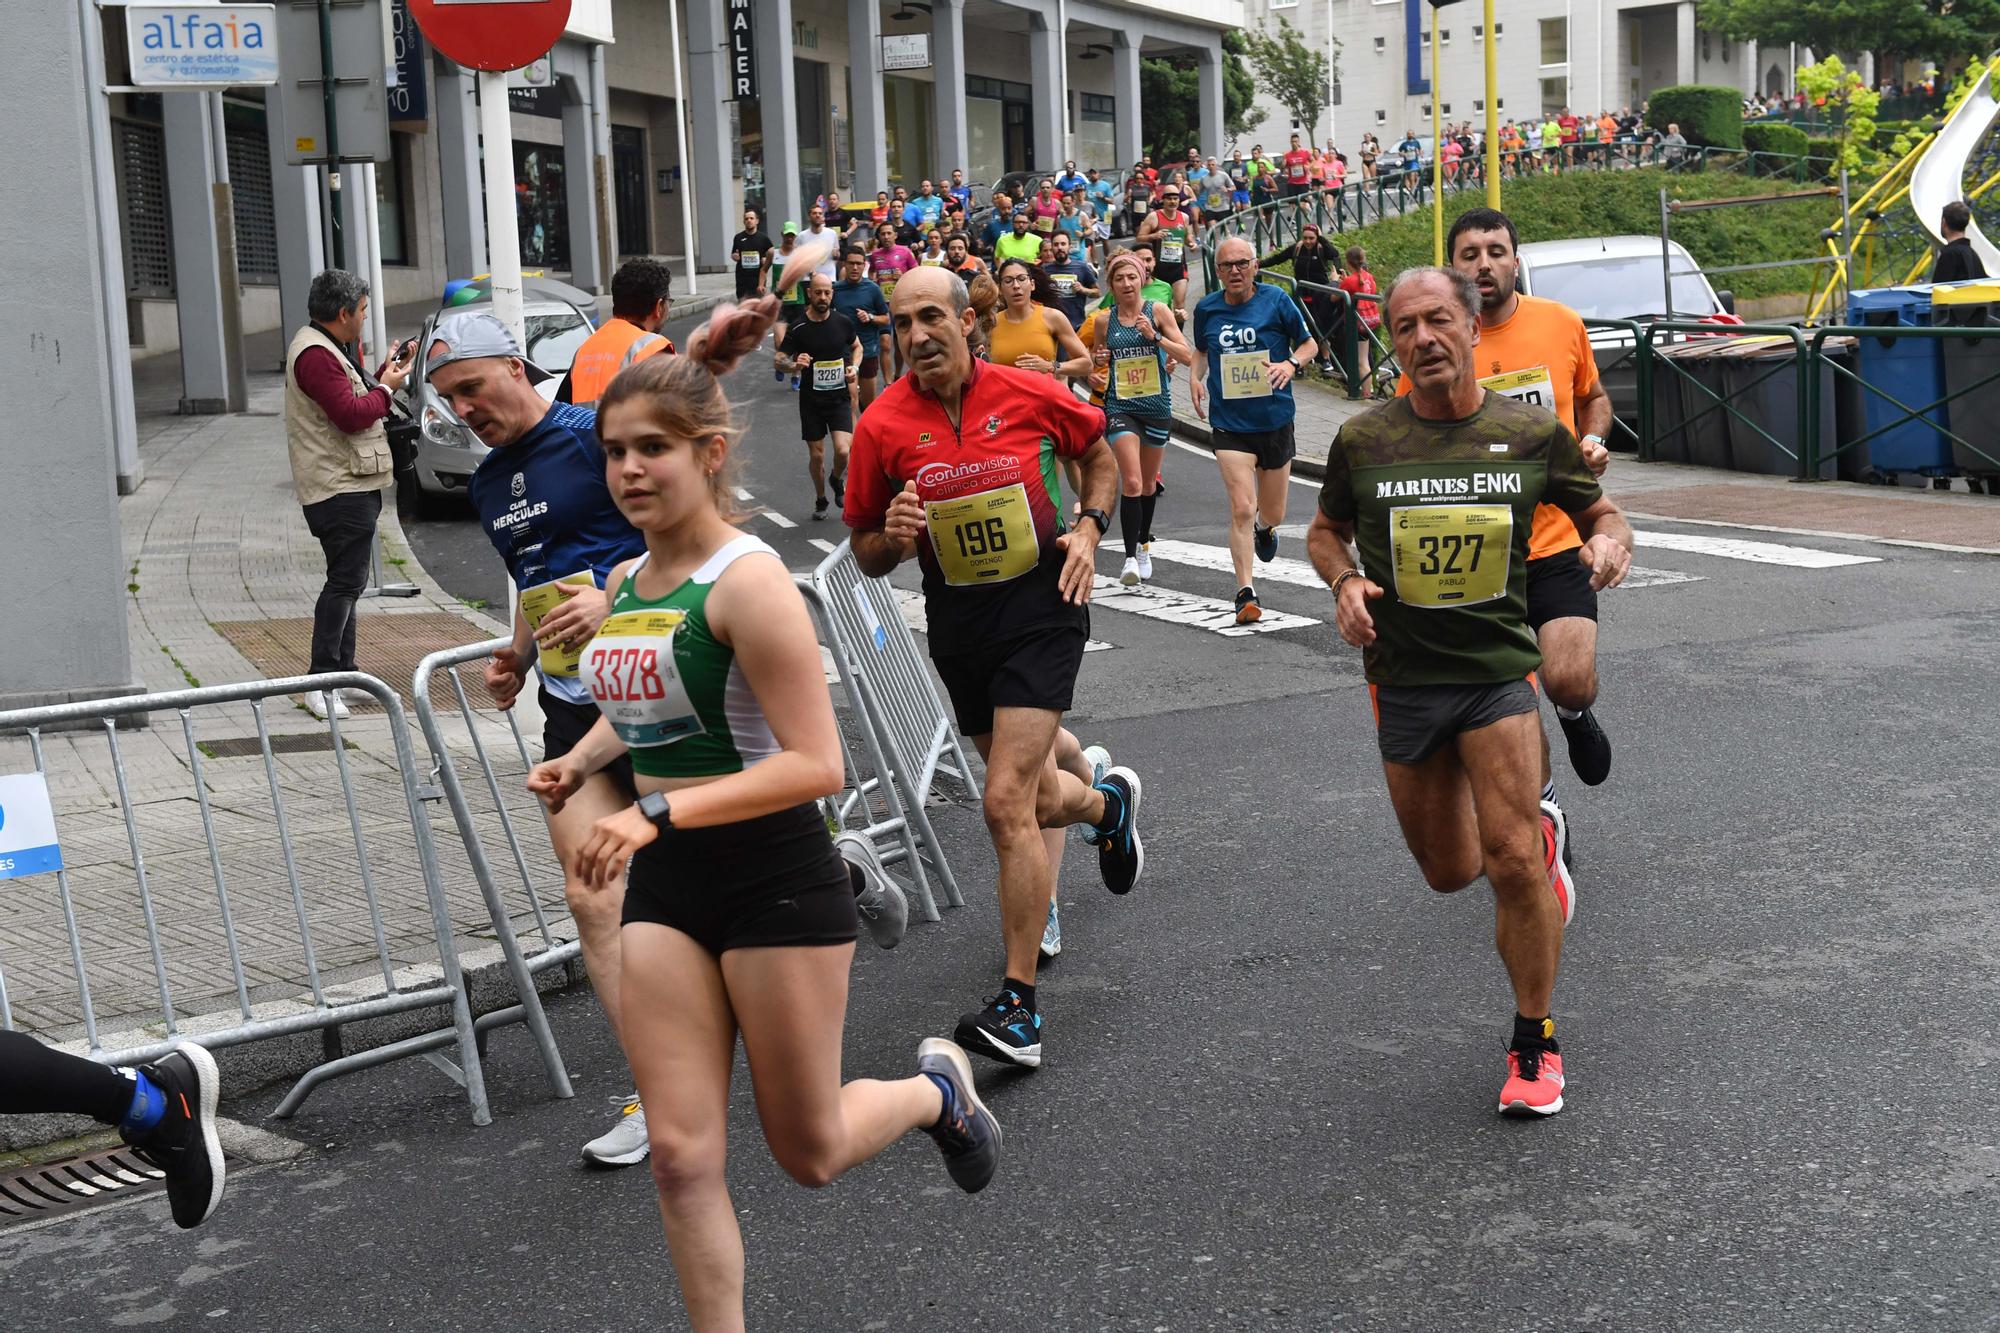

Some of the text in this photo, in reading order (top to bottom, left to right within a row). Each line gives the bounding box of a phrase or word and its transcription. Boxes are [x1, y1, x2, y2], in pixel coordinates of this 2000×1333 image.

[143, 14, 263, 49] alfaia
[144, 53, 240, 64] centro de estética
[168, 64, 240, 76] y quiromasaje
[817, 367, 841, 382] 3287
[1231, 365, 1260, 384] 644
[924, 455, 1020, 485] coruñavisión
[936, 470, 1022, 497] clínica ocular
[1376, 472, 1522, 499] MARINES ENKI
[492, 501, 548, 531] HERCULES
[509, 499, 528, 511] CLUB
[955, 517, 1008, 557] 196
[970, 555, 1003, 567] DOMINGO
[1419, 534, 1484, 575] 327
[1439, 577, 1466, 587] PABLO
[591, 648, 665, 702] 3328
